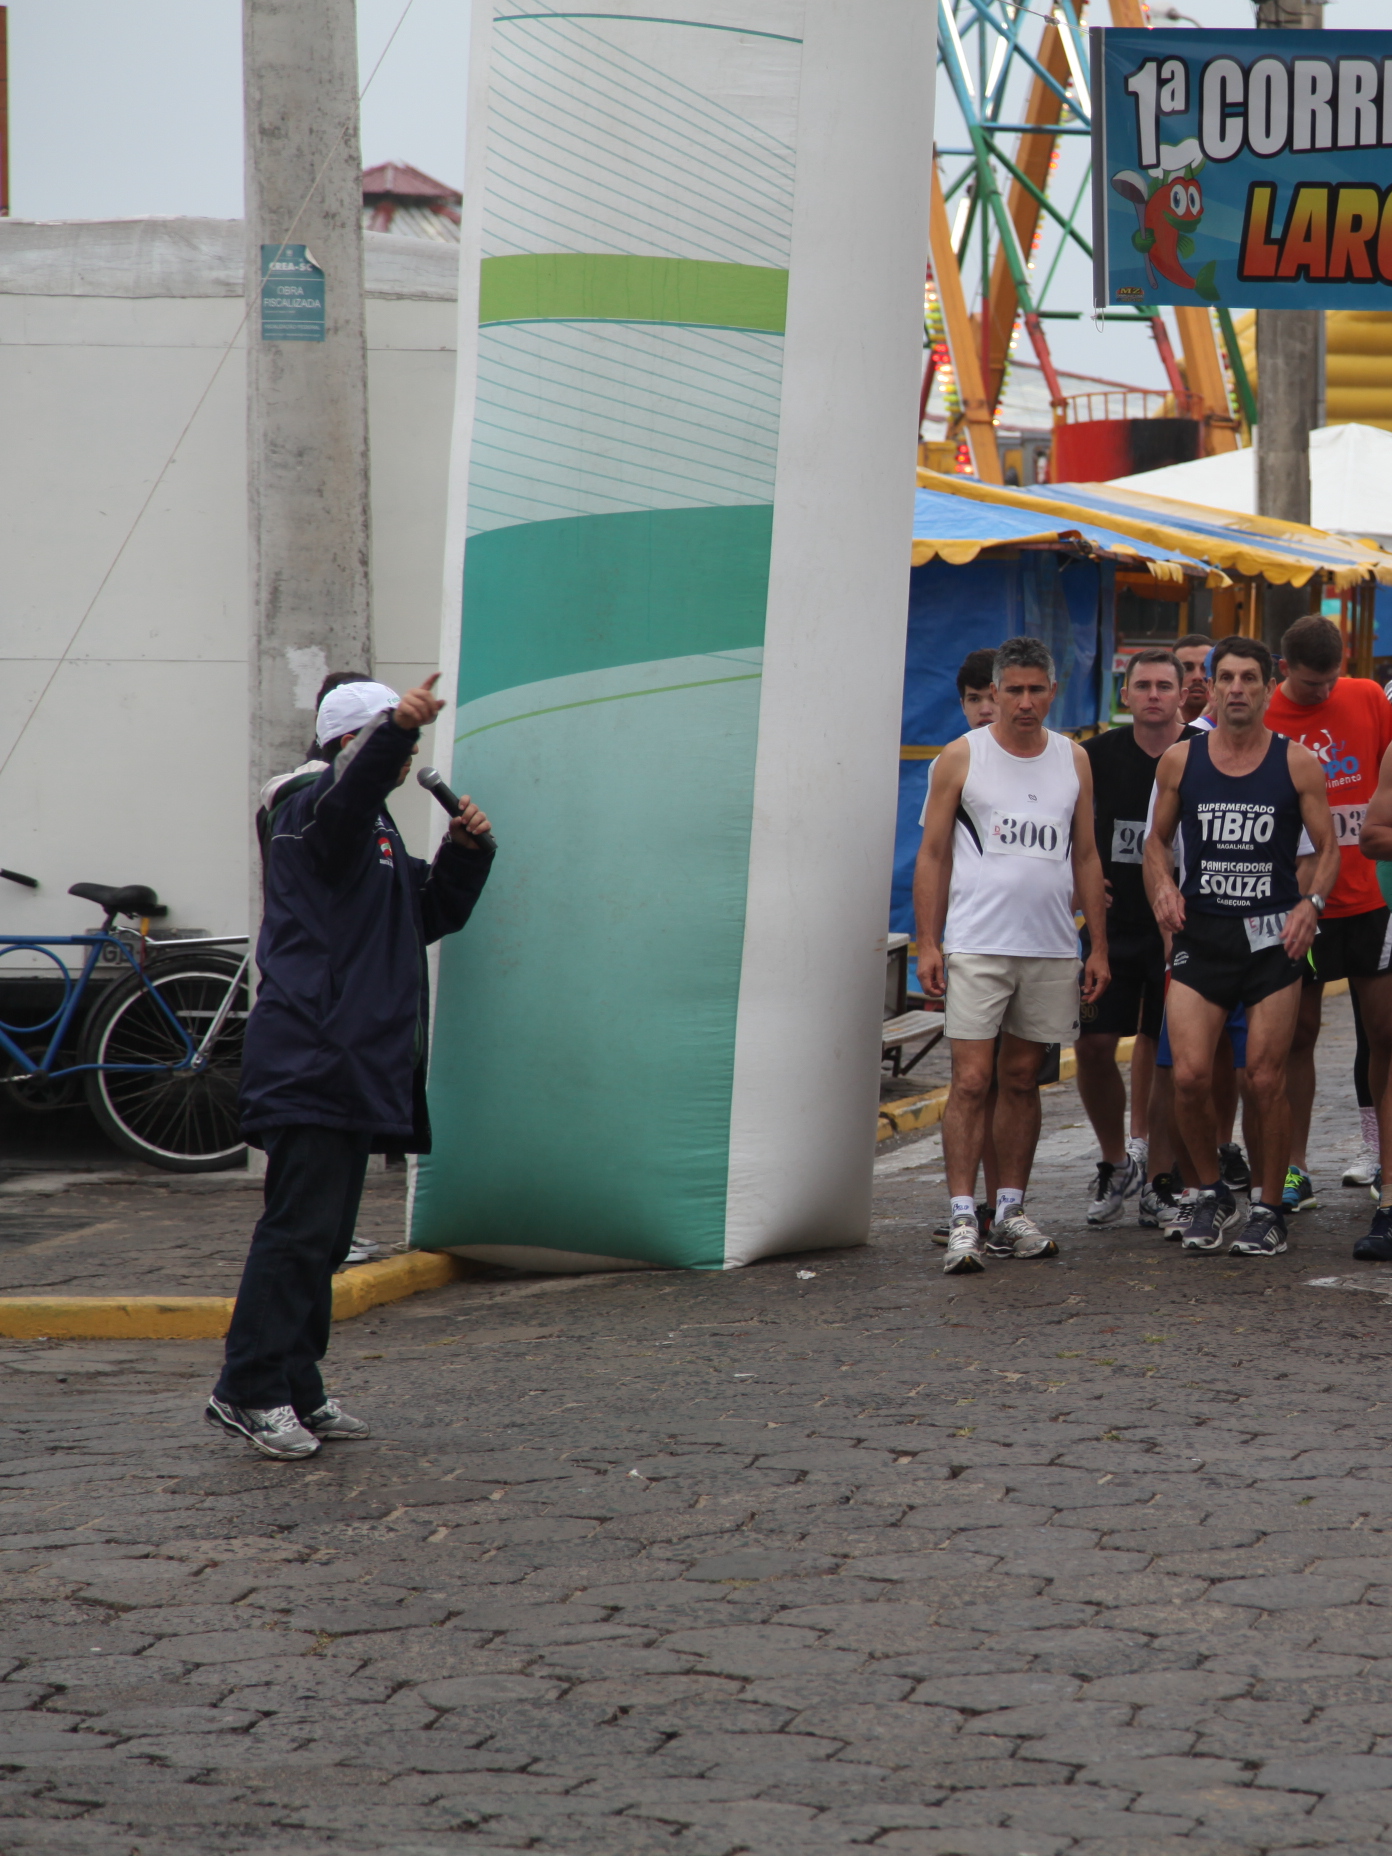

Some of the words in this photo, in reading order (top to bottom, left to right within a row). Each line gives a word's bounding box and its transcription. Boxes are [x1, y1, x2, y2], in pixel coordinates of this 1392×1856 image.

[268, 262, 314, 271] CREA-SC
[276, 286, 304, 295] OBRA
[264, 298, 322, 308] FISCALIZADA
[1197, 803, 1275, 813] SUPERMERCADO
[1000, 818, 1058, 851] 300
[1216, 843, 1255, 851] MAGALHÃES
[1201, 860, 1273, 872] PANIFICADORA
[1199, 874, 1272, 899] SOUZA
[1216, 898, 1251, 907] CABEÇUDA
